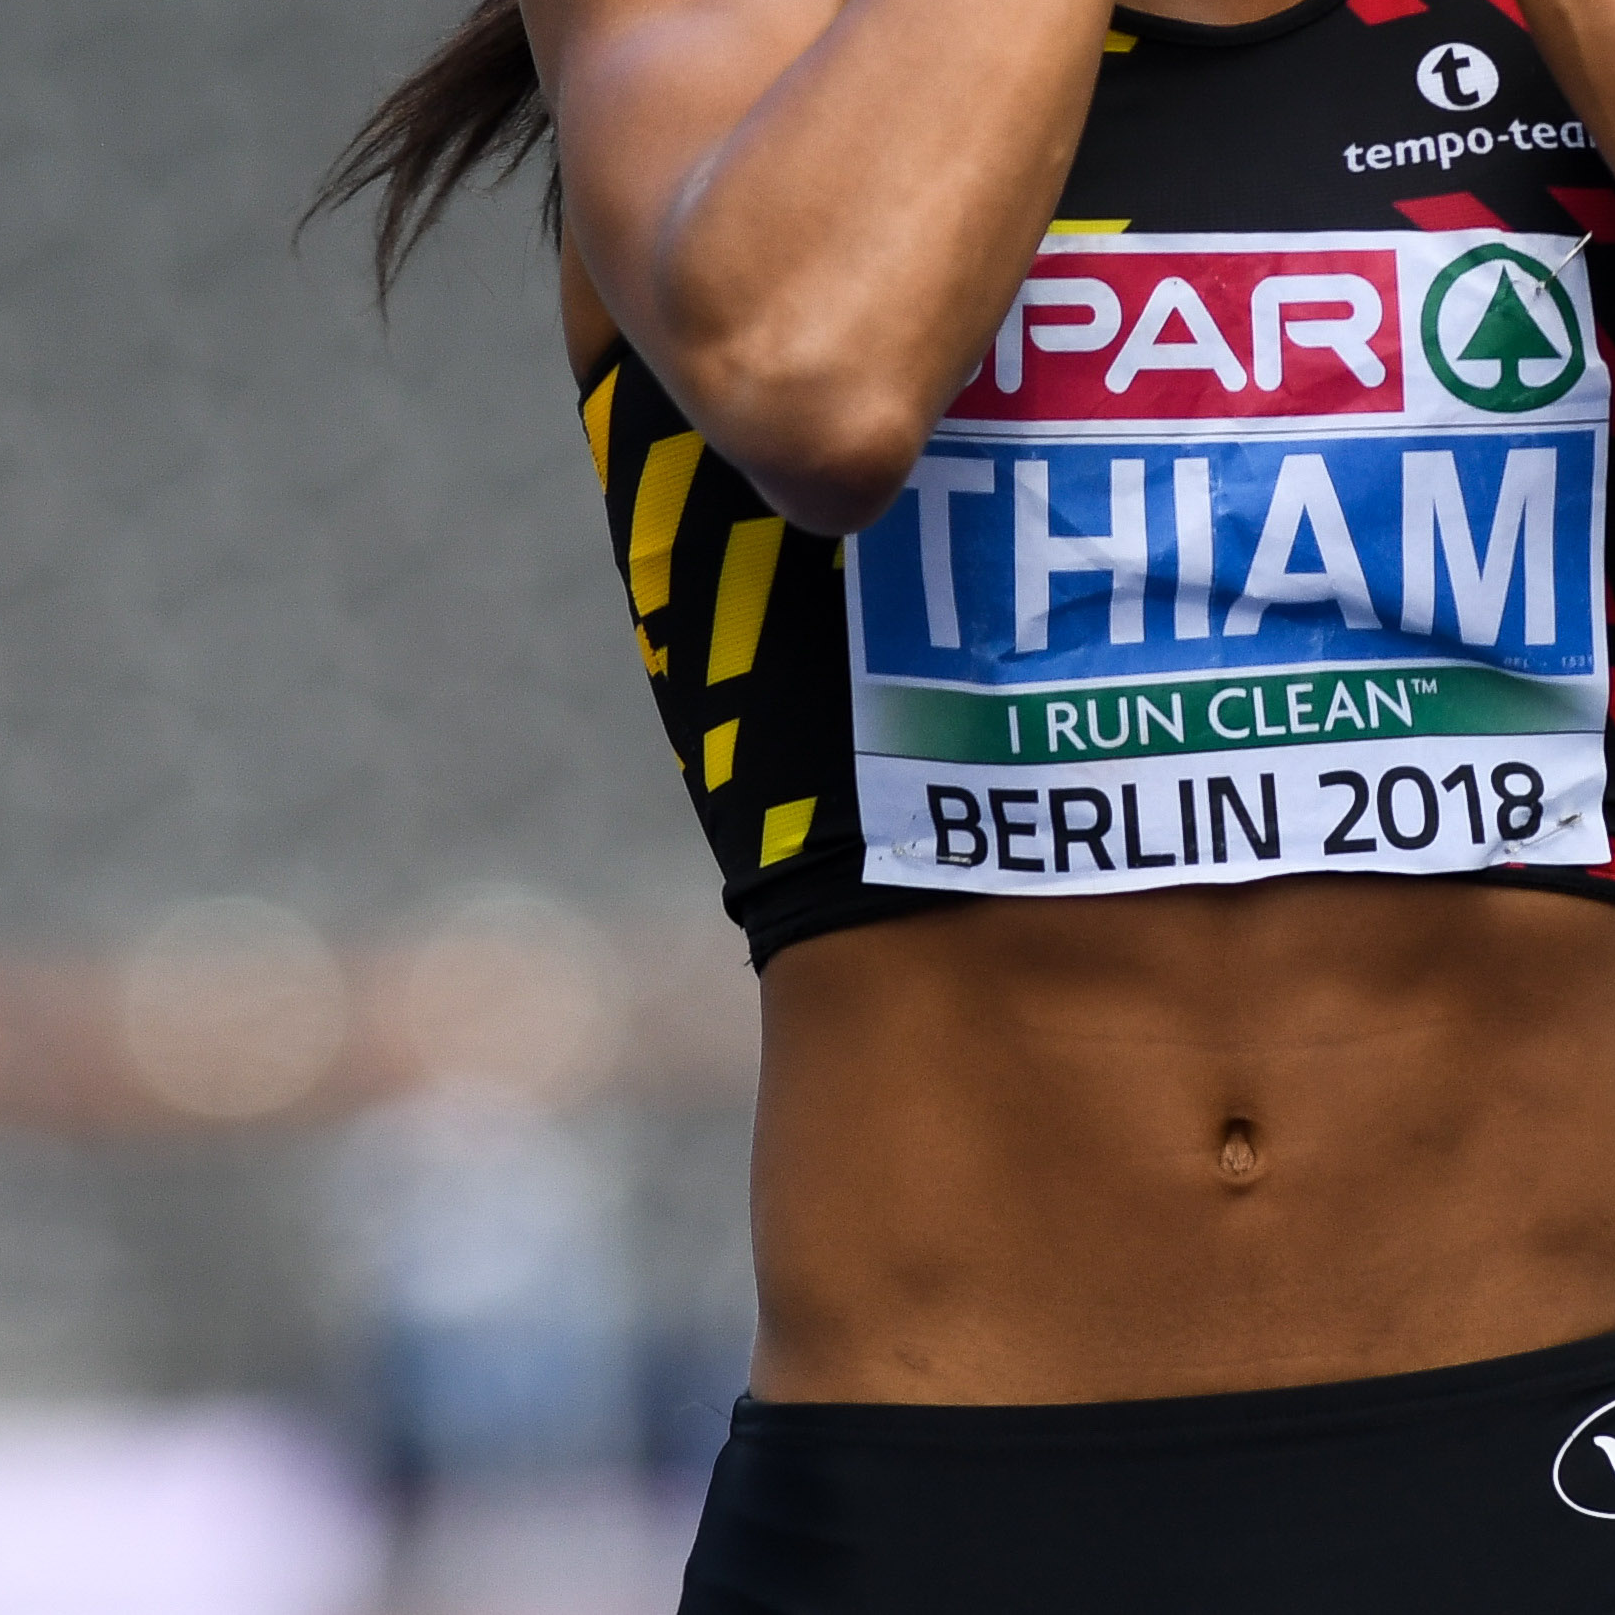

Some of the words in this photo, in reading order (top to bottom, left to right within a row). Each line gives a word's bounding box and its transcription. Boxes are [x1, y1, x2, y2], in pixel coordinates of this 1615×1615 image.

[1343, 118, 1595, 173] tempo-tea
[964, 276, 1385, 393] PAR
[904, 448, 1558, 653] THIAM
[1007, 704, 1020, 754] I
[1047, 696, 1184, 751] RUN
[926, 773, 1282, 873] BERLIN
[1317, 762, 1544, 857] 2018
